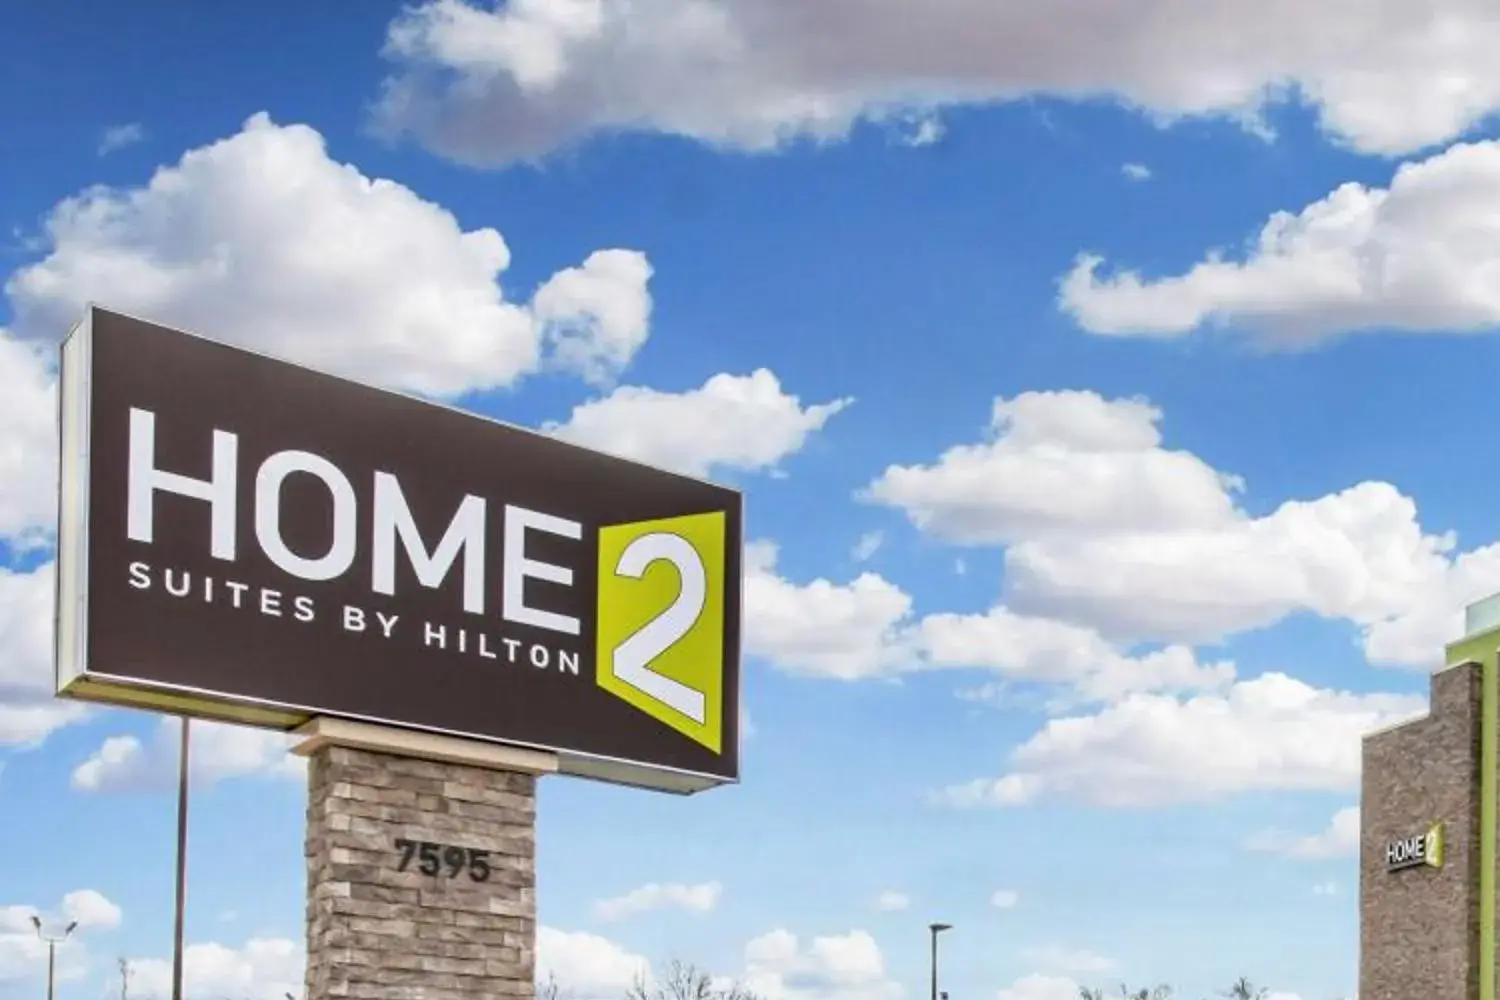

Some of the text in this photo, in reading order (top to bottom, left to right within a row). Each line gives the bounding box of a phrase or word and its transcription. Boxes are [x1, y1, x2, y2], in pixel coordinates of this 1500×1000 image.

[128, 561, 581, 675] SUITES BY HILTON
[394, 838, 491, 882] 7595
